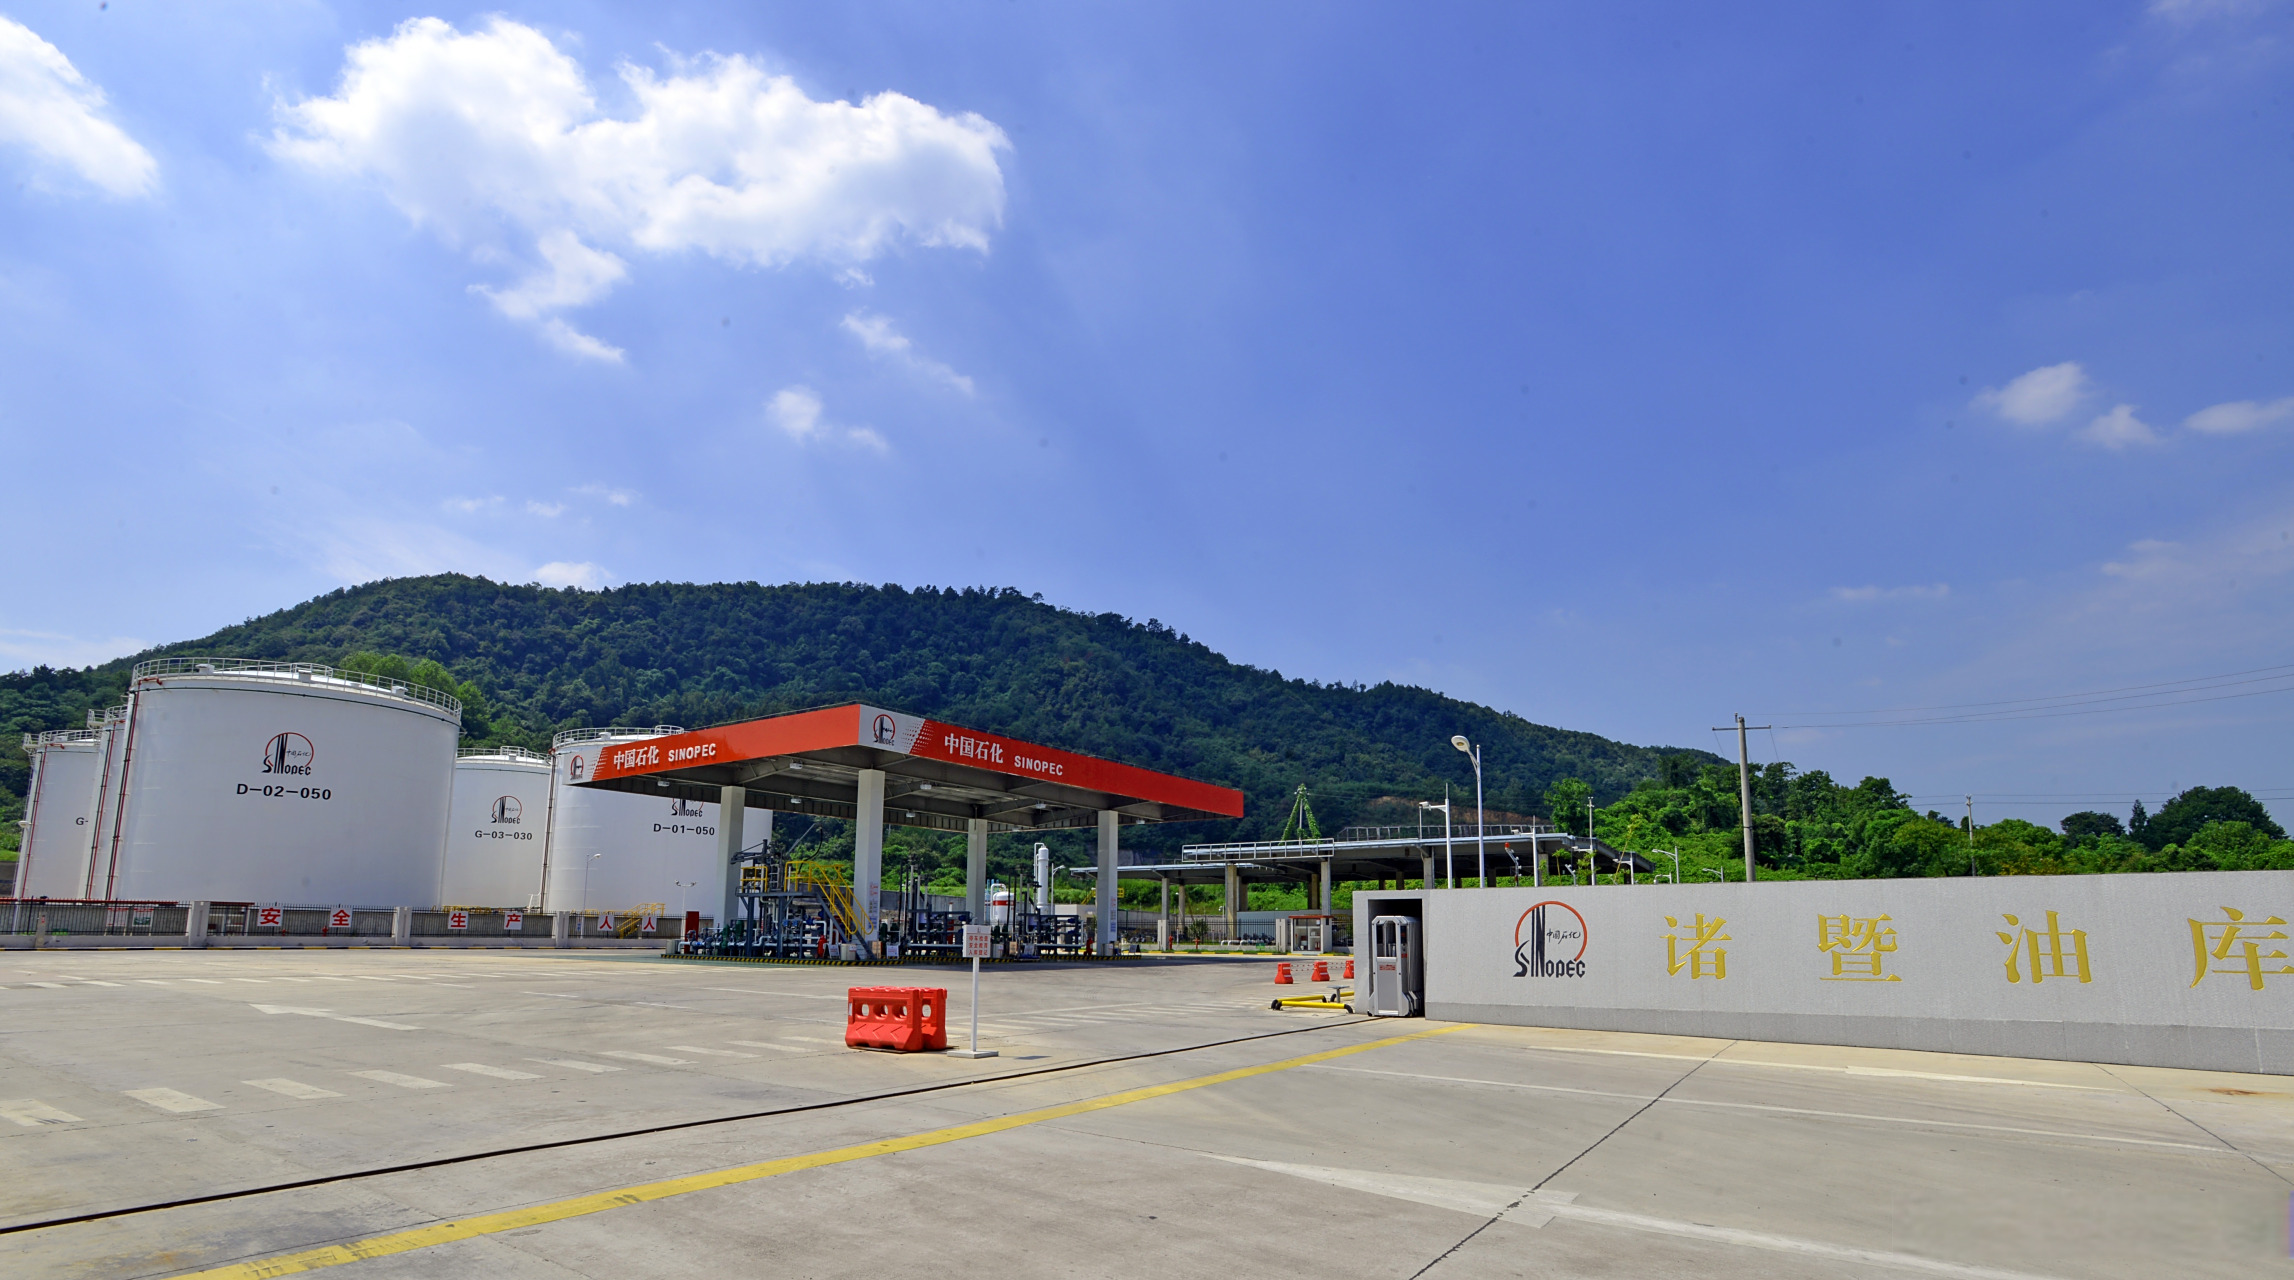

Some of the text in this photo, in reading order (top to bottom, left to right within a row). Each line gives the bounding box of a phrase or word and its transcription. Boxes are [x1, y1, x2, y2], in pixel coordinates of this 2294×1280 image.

[613, 743, 716, 770] 中国石化 SINOPEC
[944, 733, 1064, 776] 中国石化 SINOPEC
[236, 783, 332, 801] D-02-050
[474, 829, 533, 841] G-03-030
[653, 823, 715, 836] D-01-050
[1513, 904, 1586, 978] SINOPEC
[1659, 905, 2294, 992] 诸暨油库
